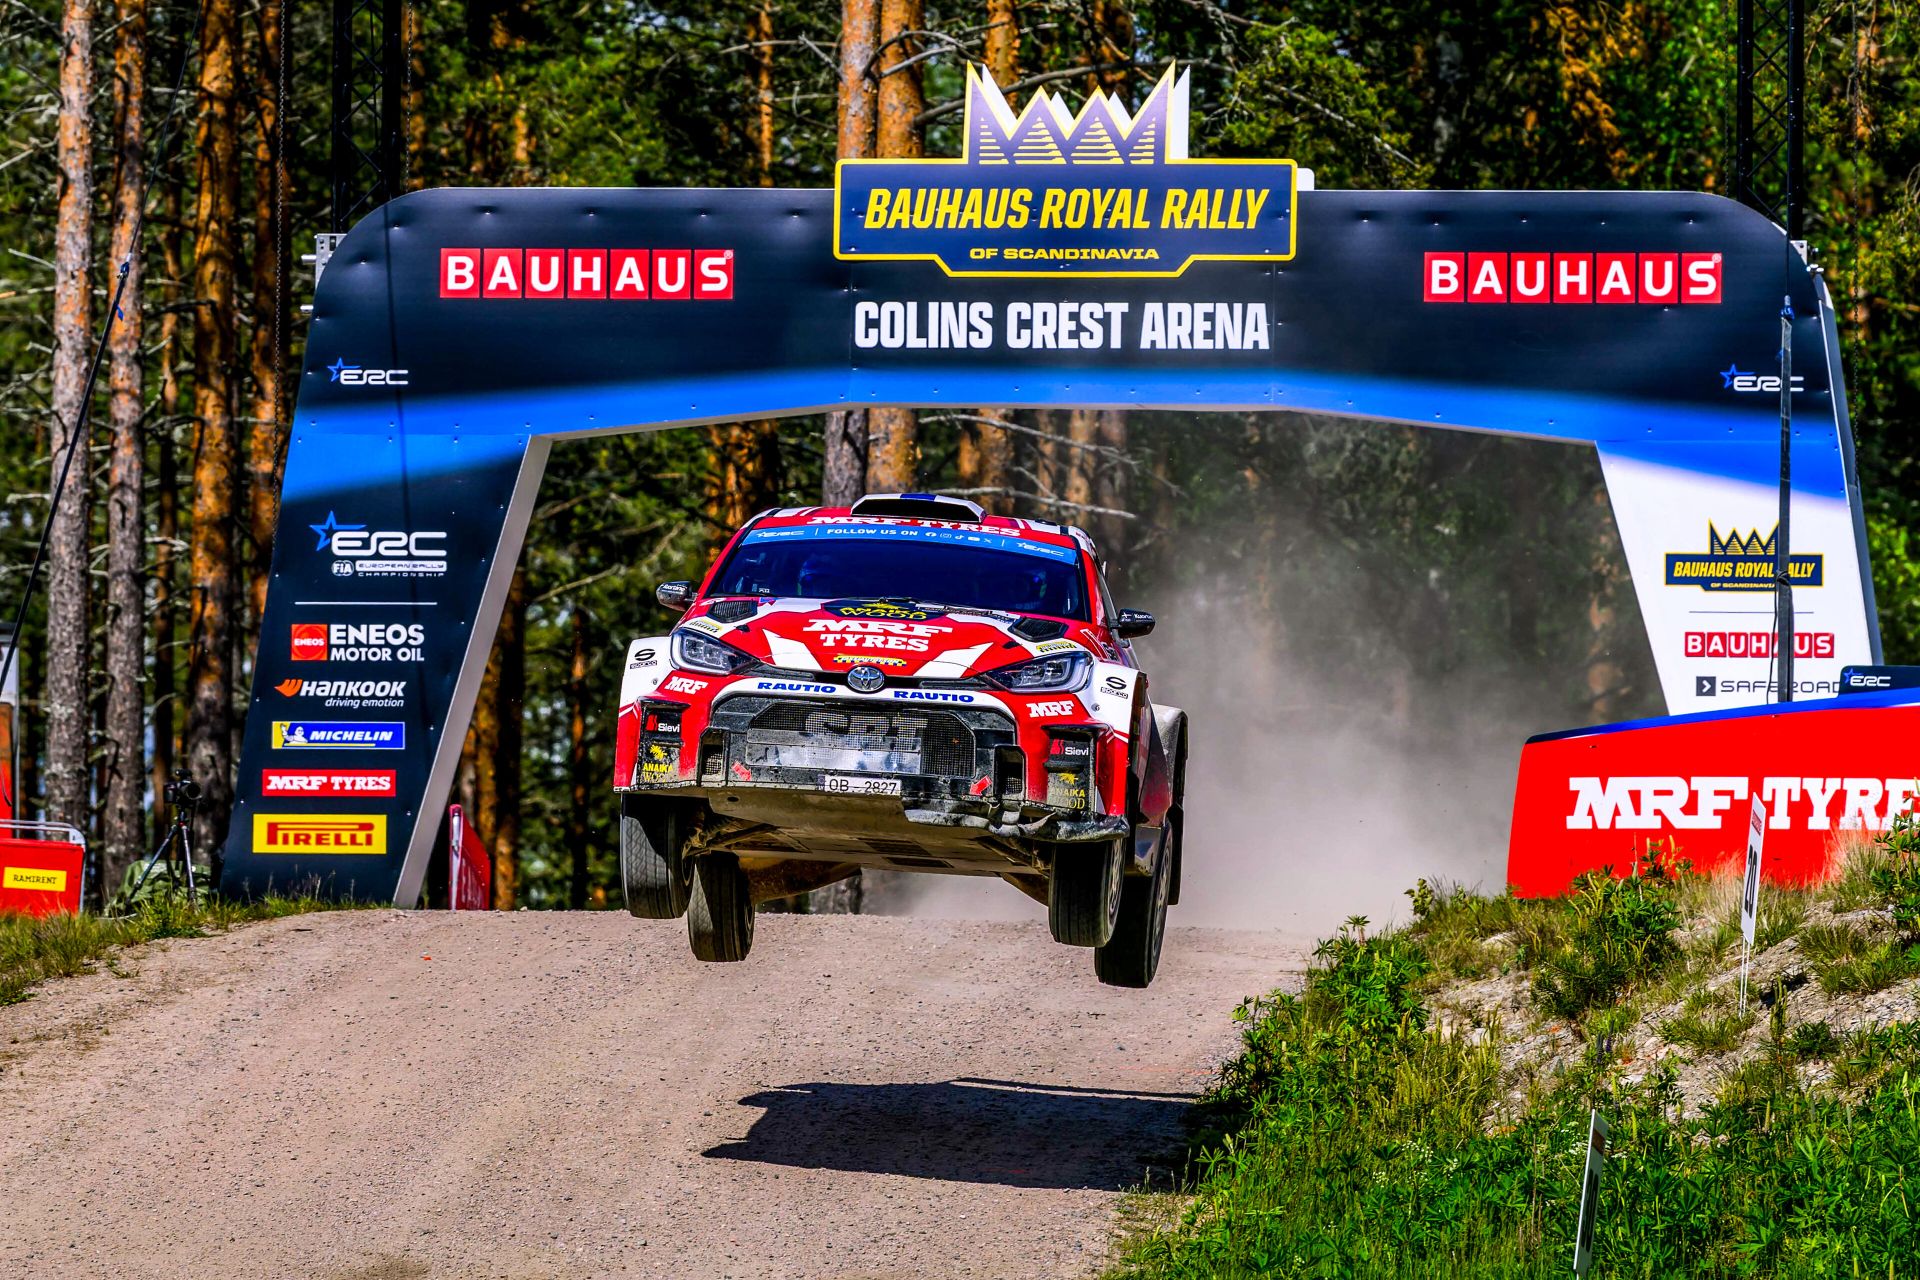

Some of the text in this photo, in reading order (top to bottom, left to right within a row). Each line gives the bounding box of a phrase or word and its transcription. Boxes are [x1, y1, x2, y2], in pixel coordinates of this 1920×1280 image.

[864, 188, 1270, 229] BAUHAUS ROYAL RALLY
[969, 248, 1160, 260] OF SCANDINAVIA
[446, 254, 730, 293] BAUHAUS
[1430, 258, 1720, 297] BAUHAUS
[854, 301, 1270, 350] COLINS CREST ARENA
[340, 369, 409, 385] ERC
[806, 516, 1021, 537] MRF TYRES
[331, 531, 447, 557] ERC
[332, 561, 445, 577] FIA EUROPEAN RALLY
[1673, 561, 1816, 578] BAUHAUS ROYAL ALLY
[330, 622, 425, 646] ENEOS
[802, 618, 953, 638] MRF
[293, 638, 325, 646] ENEOS
[819, 633, 929, 652] TYRES
[1687, 635, 1832, 655] BAUHUS
[329, 647, 426, 662] MOTOR OIL
[664, 676, 709, 695] MRF
[757, 681, 837, 694] RAUTIO
[325, 697, 404, 708] driving emotion
[893, 690, 975, 703] RAUTIO
[1026, 700, 1075, 718] MRF
[309, 730, 393, 742] MICHELIN
[657, 722, 681, 733] Sievi
[1064, 746, 1089, 757] Sievi
[266, 776, 391, 791] MRF TYRES
[1566, 776, 1749, 829] MRF
[266, 822, 376, 846] PIRELLI
[13, 873, 58, 885] RAMIRENT
